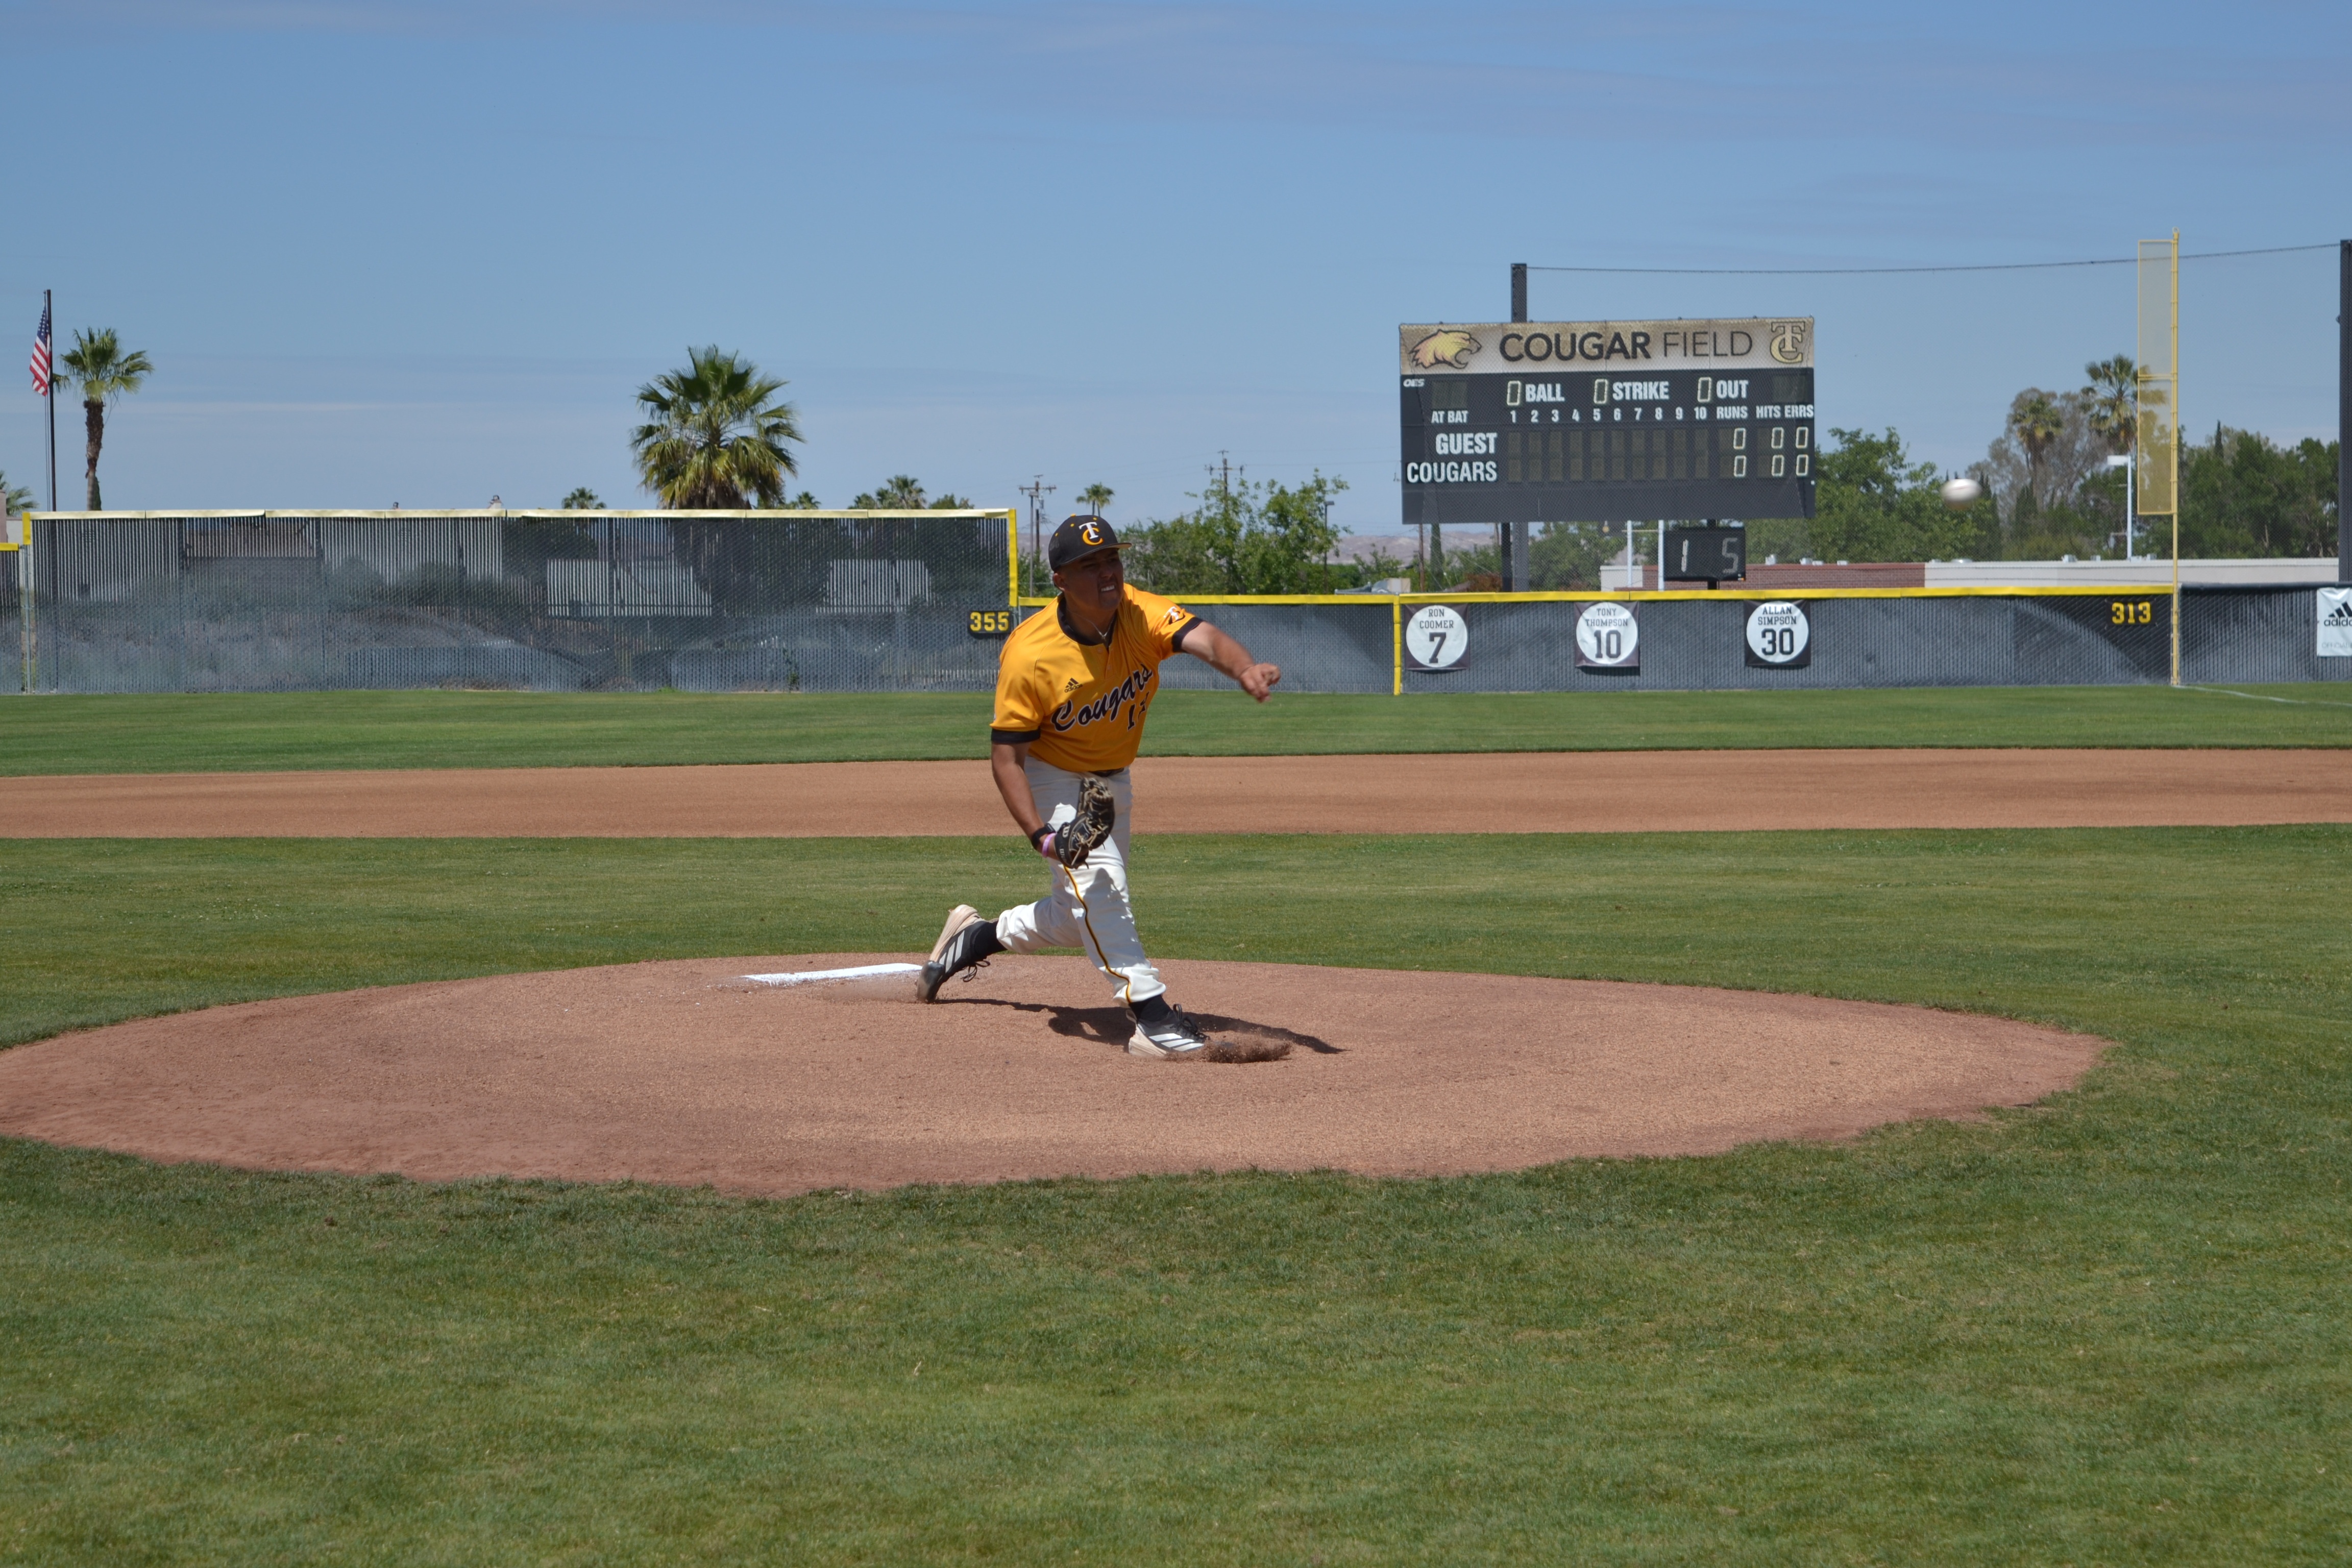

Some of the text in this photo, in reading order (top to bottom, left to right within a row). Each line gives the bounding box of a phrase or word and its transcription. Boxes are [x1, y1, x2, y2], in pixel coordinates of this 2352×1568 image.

[1499, 331, 1753, 361] COUGAR FIELD
[1506, 377, 1749, 406] 0 BALL 0 STRIKE 0 OUT
[1431, 410, 1468, 423] AT BAT
[1510, 404, 1814, 423] 1 2 3 4 5 6 7 8 9 10 RUNS HITS ERRS
[1435, 427, 1808, 454] GUEST 0 0 0
[1407, 454, 1808, 483] COUGARS 0 0 0
[1079, 522, 1103, 545] TC
[970, 611, 1009, 631] 355
[1428, 608, 1444, 617] RON
[1597, 608, 1616, 616] TONY
[1758, 616, 1797, 625] SIMPSON
[1762, 606, 1792, 615] ALLAN
[2112, 602, 2151, 624] 313
[1419, 620, 1454, 629] COOMER
[1585, 618, 1628, 627] THOMPSON
[1429, 632, 1447, 664] 7
[1594, 630, 1621, 658] 10
[1761, 628, 1794, 655] 30
[1051, 663, 1153, 732] Cougars
[1064, 684, 1083, 693] adidas
